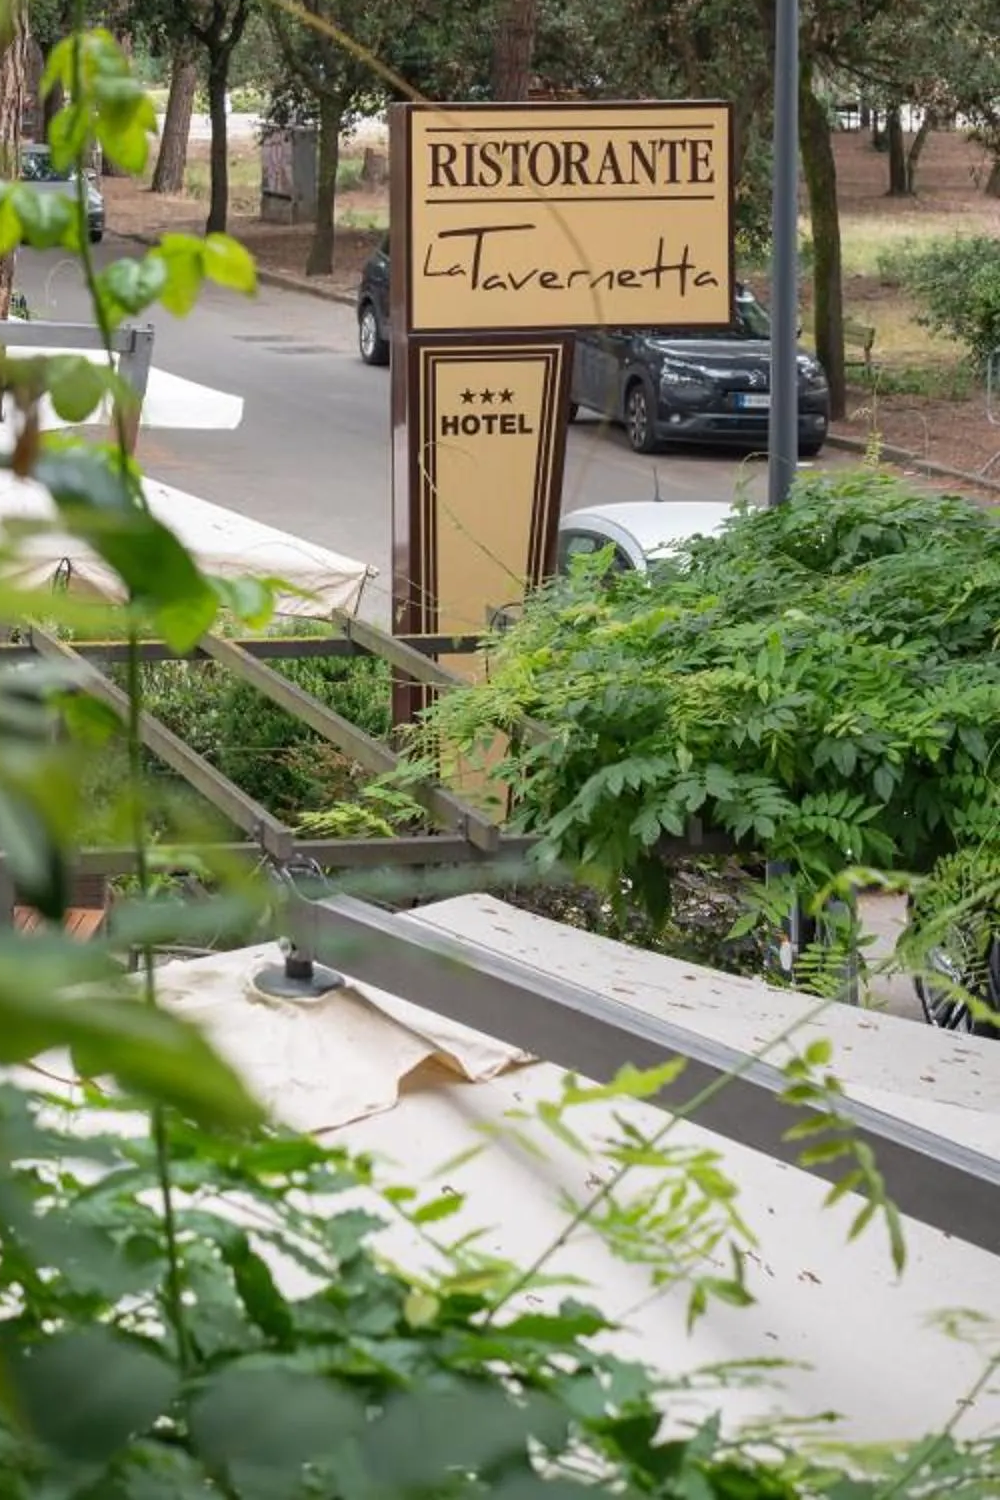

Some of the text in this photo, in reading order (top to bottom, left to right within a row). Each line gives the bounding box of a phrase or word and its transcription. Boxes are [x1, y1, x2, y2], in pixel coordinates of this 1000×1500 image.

[427, 139, 715, 187] RISTORANTE
[423, 223, 720, 297] La Tavernetta
[441, 414, 533, 436] HOTEL
